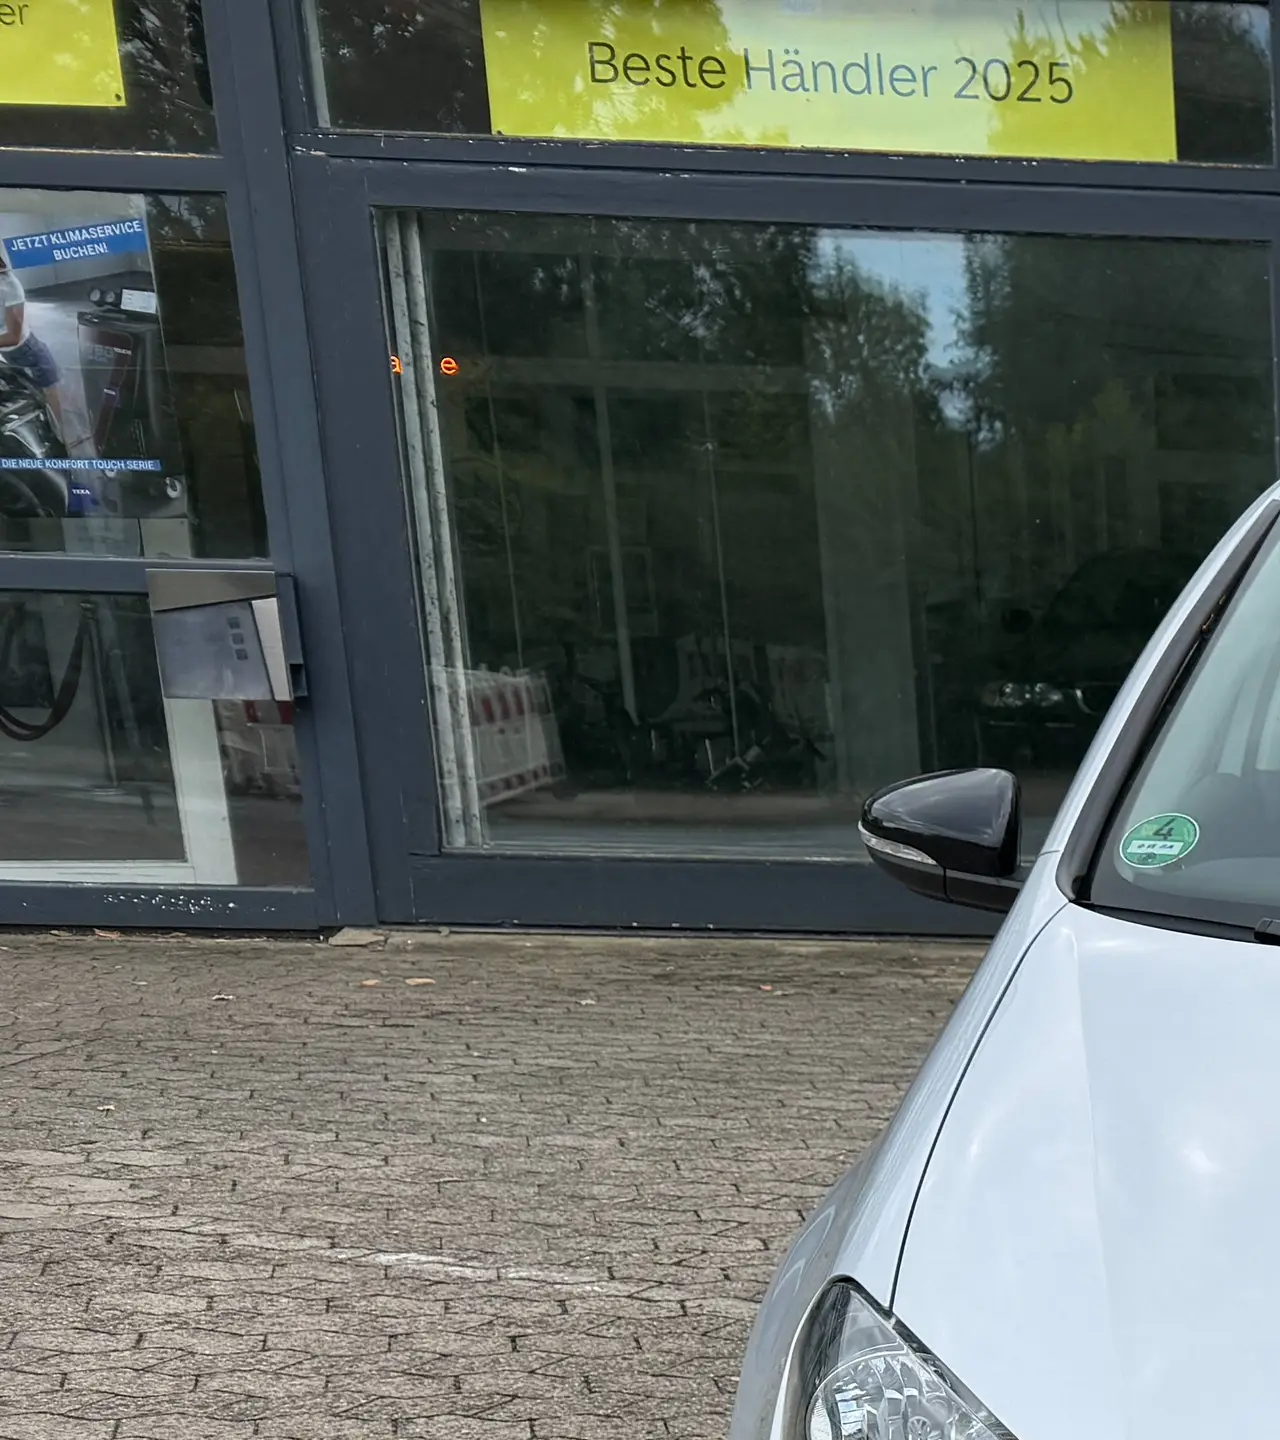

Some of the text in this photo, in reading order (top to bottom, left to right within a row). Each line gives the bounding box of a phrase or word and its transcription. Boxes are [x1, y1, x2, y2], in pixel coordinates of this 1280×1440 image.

[588, 42, 1074, 104] Beste Händler 2025
[11, 220, 143, 251] JETZT KLIMASERVICE
[53, 242, 109, 261] BUCHEN!
[1, 458, 156, 471] DIE NEUE KONFORT TOUCH SERIE
[1152, 817, 1176, 840] 4
